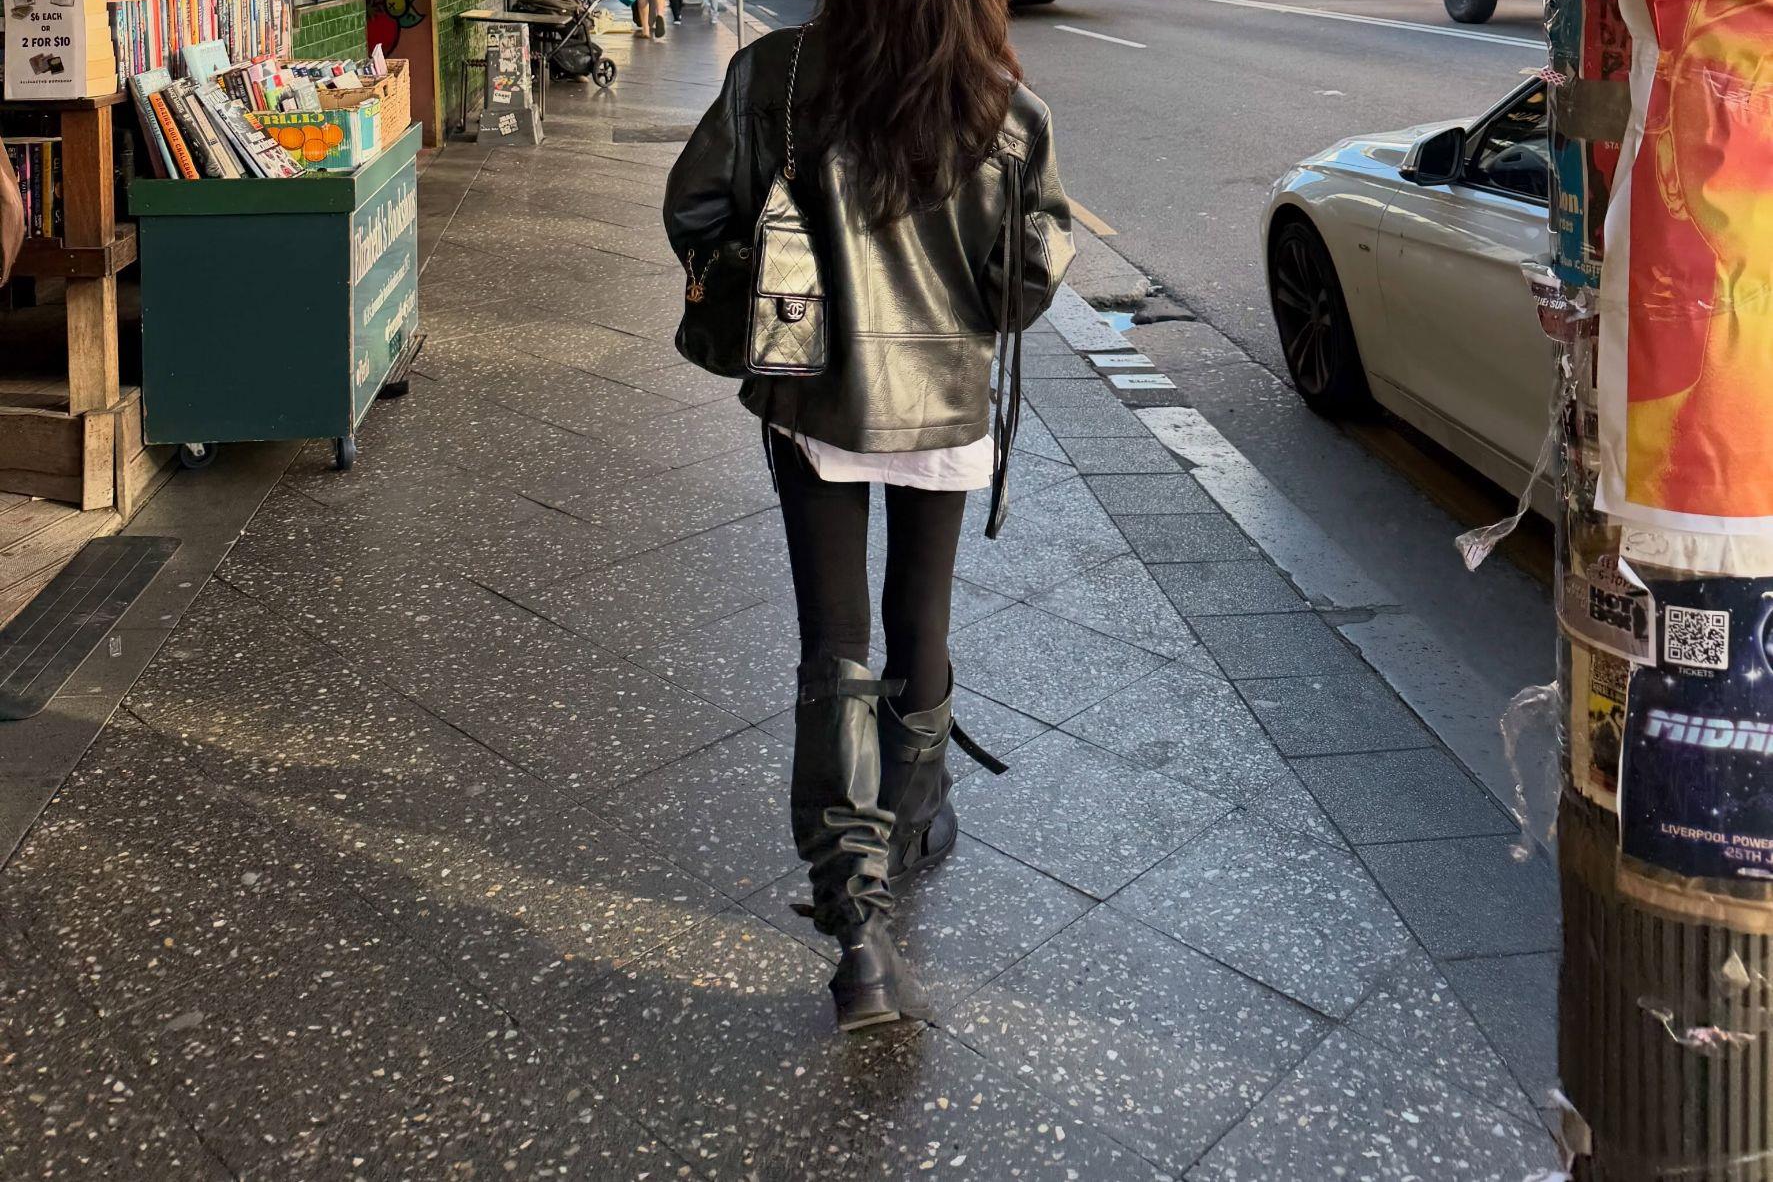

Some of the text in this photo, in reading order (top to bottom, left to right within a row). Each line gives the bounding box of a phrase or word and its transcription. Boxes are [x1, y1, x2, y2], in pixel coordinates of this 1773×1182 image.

[30, 12, 63, 22] $6 EACH
[22, 36, 71, 47] 2 FOR $10
[155, 97, 172, 127] AMAZING
[168, 127, 179, 142] QUIZ
[175, 143, 194, 179] CHALLENGE
[1589, 584, 1635, 614] HOT
[1678, 667, 1715, 679] TICKETS
[1661, 822, 1728, 844] LIVERPOOL
[1724, 845, 1762, 863] 25TH
